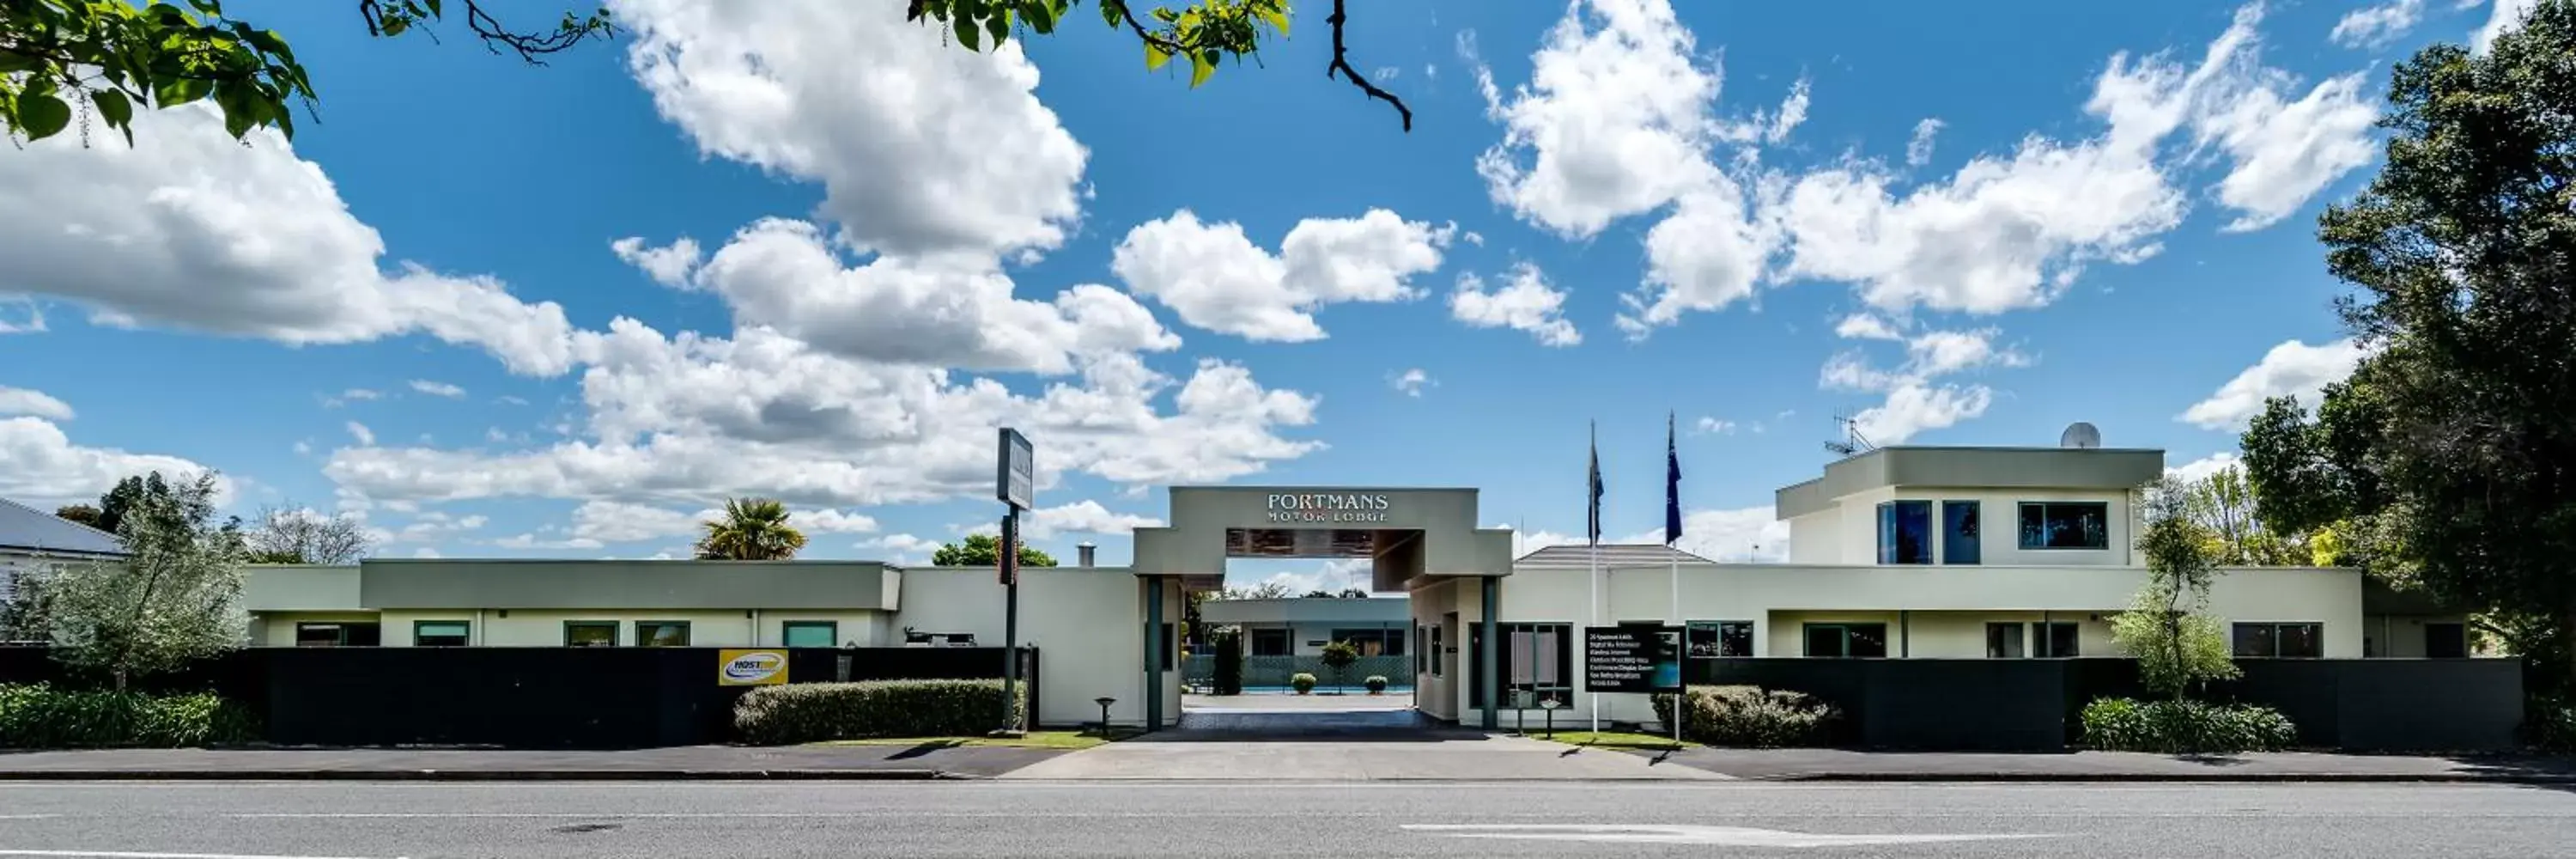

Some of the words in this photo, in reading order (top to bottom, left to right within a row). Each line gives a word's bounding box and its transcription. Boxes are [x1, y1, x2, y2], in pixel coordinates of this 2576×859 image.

[1268, 494, 1388, 509] PORTMANS
[1268, 511, 1326, 521] MOTOR
[1334, 511, 1388, 521] LODGE
